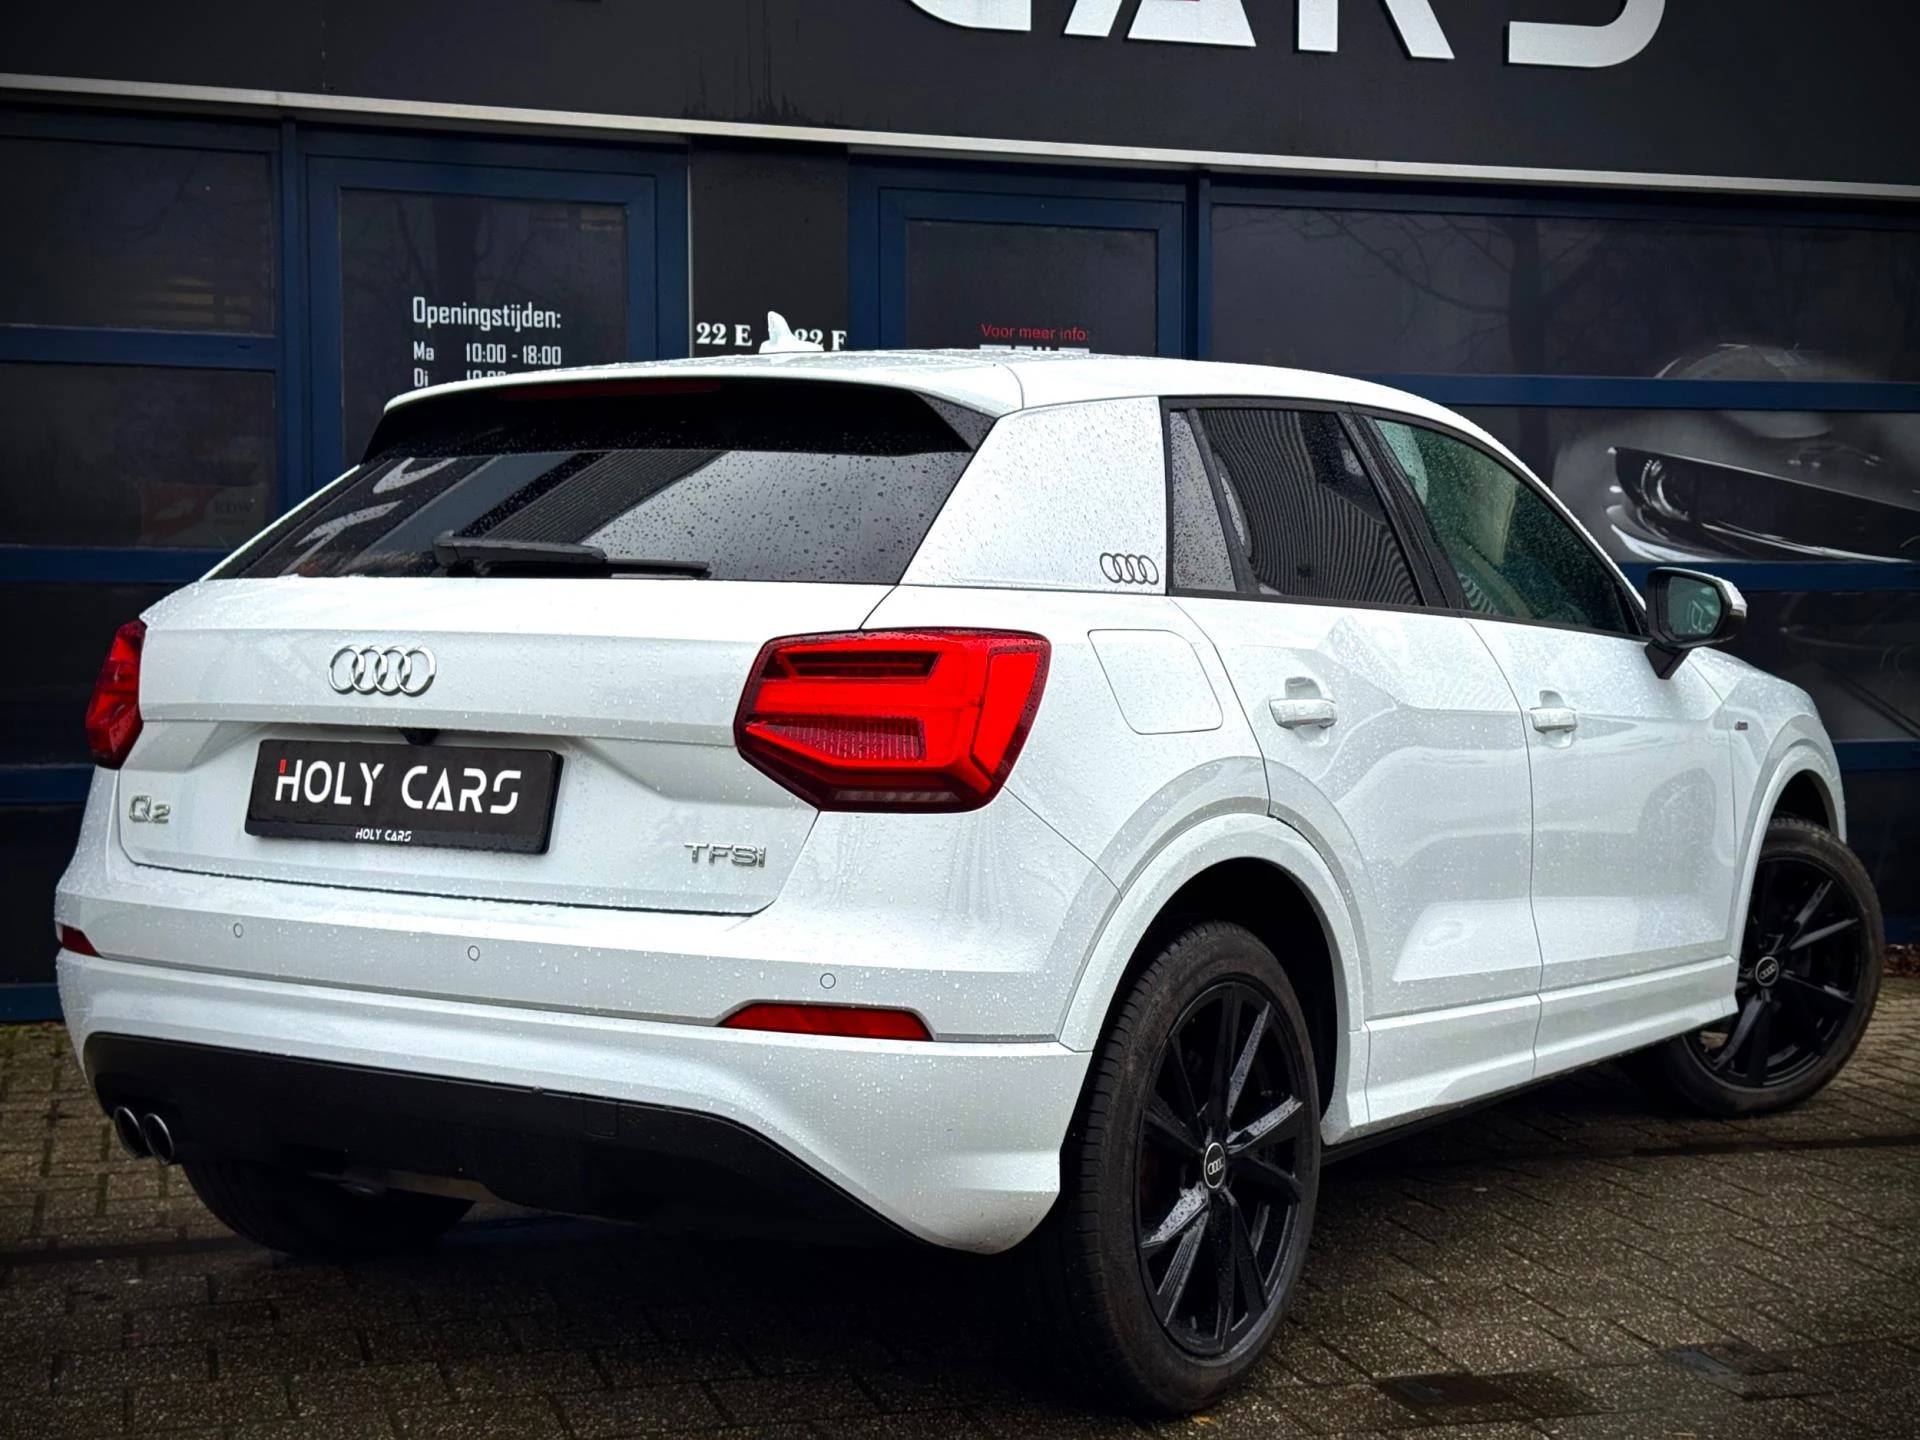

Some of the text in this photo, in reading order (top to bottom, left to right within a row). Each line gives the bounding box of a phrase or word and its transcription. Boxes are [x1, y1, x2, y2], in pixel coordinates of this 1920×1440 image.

[412, 296, 562, 333] Openingstijden:
[695, 322, 753, 347] 22 E
[831, 330, 848, 351] F
[980, 323, 1090, 342] Voor meer info:
[413, 341, 435, 362] Ma
[466, 343, 507, 364] 10:00
[522, 345, 562, 366] 18:00
[413, 368, 429, 388] Di
[275, 759, 522, 815] HOLY CARS
[129, 795, 171, 824] Q2
[355, 827, 413, 843] HOLY CARS
